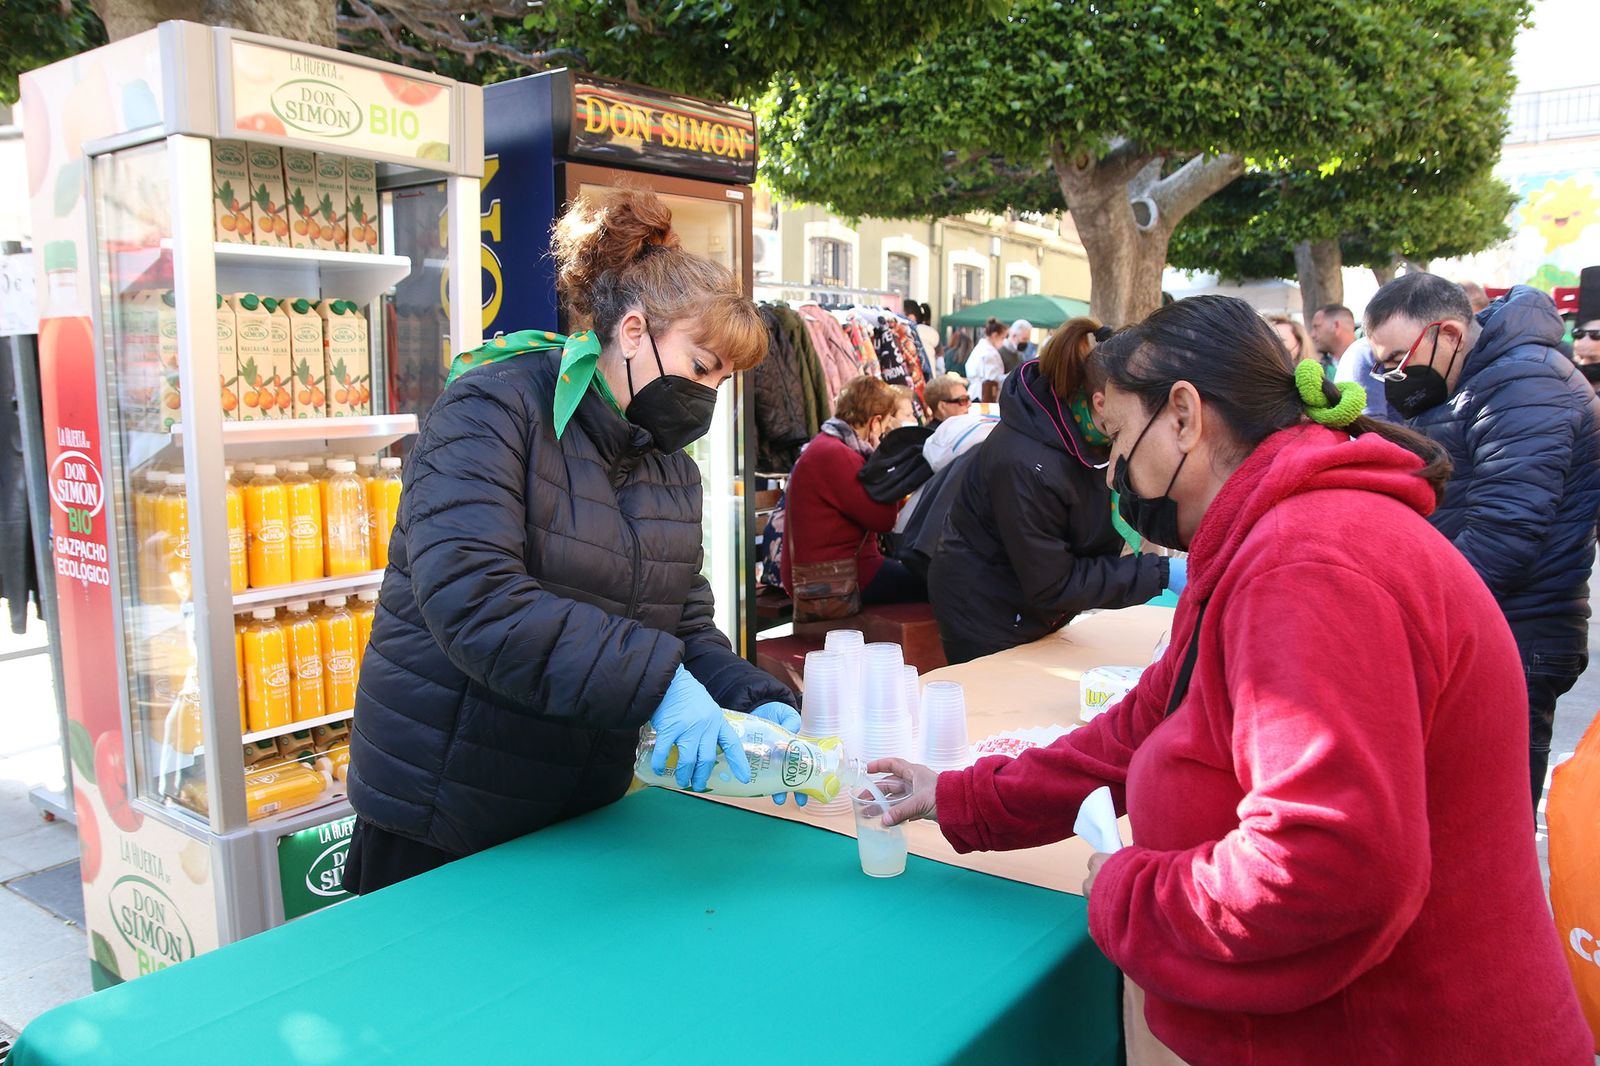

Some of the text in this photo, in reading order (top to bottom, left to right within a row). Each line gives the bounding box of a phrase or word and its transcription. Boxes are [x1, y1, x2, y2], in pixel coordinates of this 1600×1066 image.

[290, 53, 337, 80] LA HUERTA
[301, 87, 335, 107] DON
[285, 100, 350, 129] SIMON
[369, 103, 420, 141] BIO
[584, 97, 746, 160] DON SIMON
[57, 426, 65, 446] LA
[64, 462, 87, 481] DON
[57, 479, 97, 506] SIMON
[68, 507, 93, 535] BIO
[56, 536, 107, 563] GAZPACHO
[57, 558, 109, 586] ECOLÓGICO
[785, 745, 801, 782] SIMON
[318, 819, 357, 844] LA HUER
[120, 835, 131, 865] LA
[131, 841, 164, 881] HUERTA
[333, 848, 349, 867] D
[320, 866, 345, 891] SI
[133, 888, 167, 926] DON
[121, 905, 183, 962] SIMON
